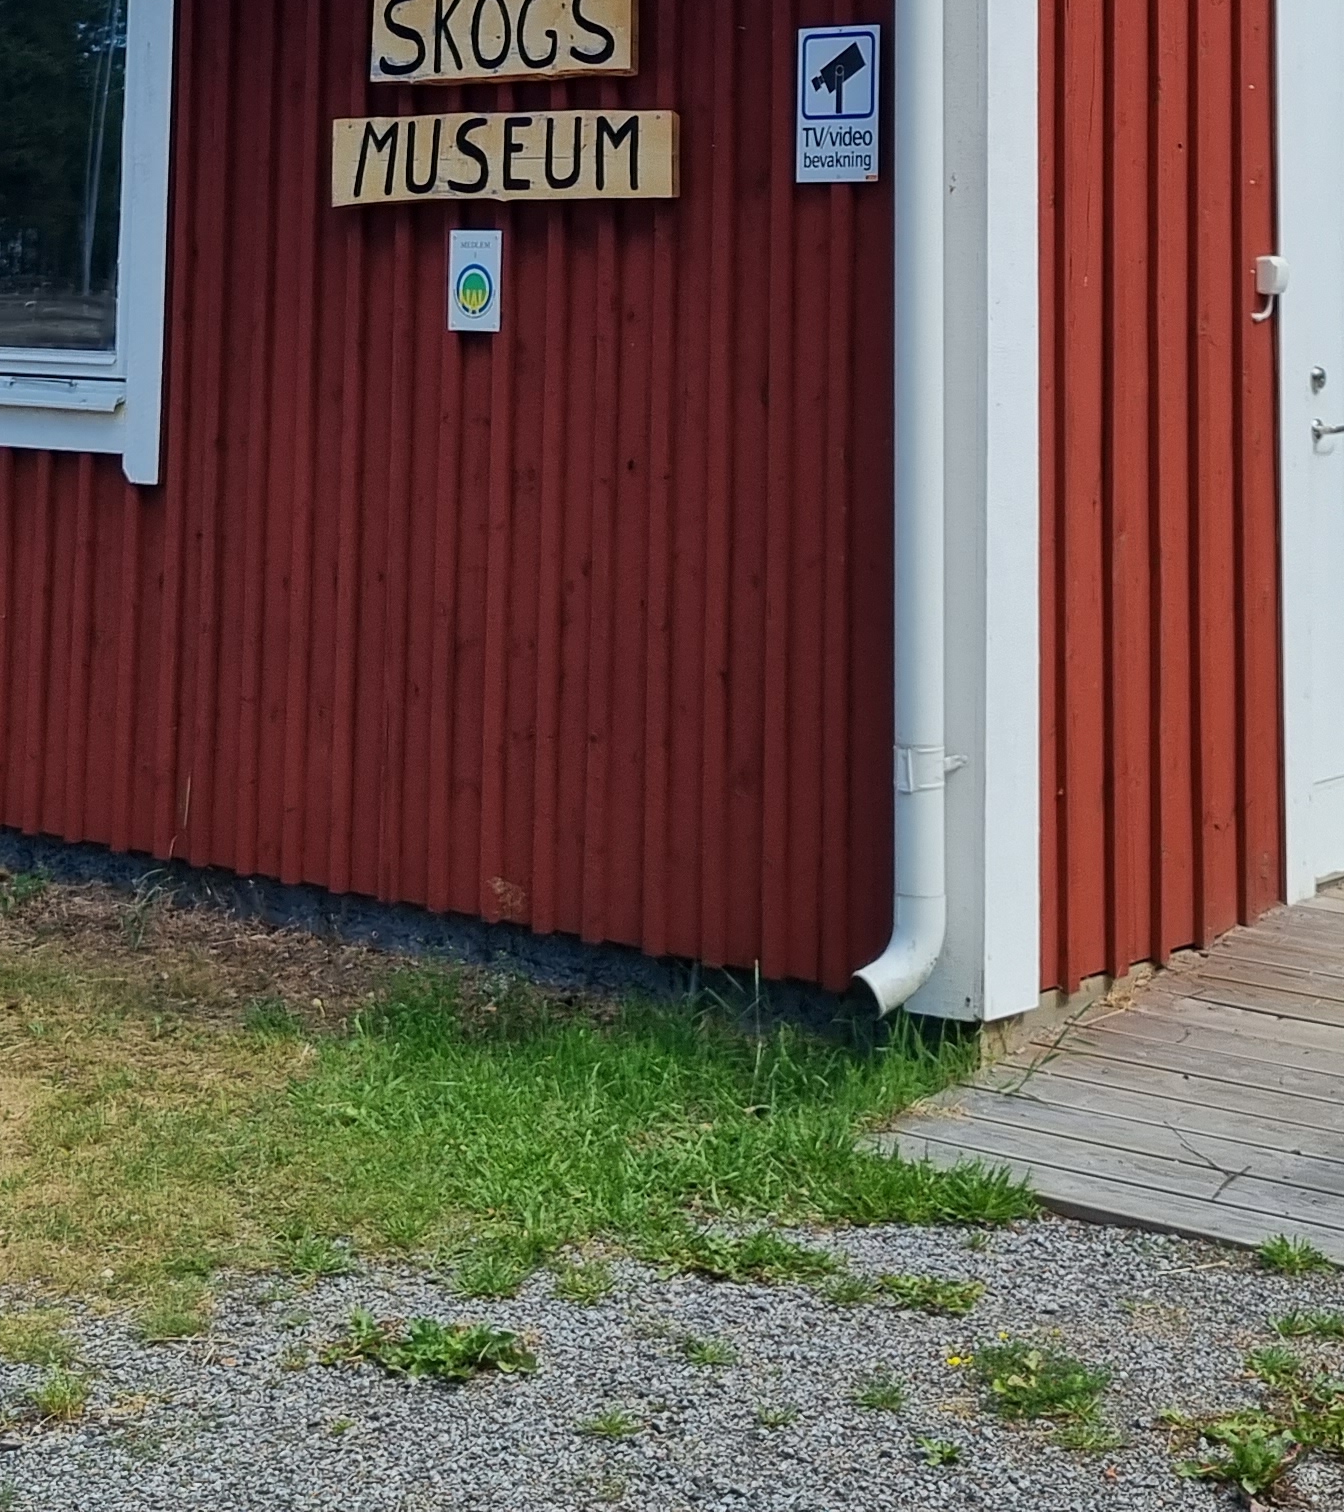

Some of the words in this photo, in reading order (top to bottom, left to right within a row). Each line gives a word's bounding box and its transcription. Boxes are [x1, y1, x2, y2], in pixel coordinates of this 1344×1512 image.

[802, 125, 873, 149] TV/video
[353, 115, 639, 197] MUSEUM
[803, 151, 872, 171] bevakning
